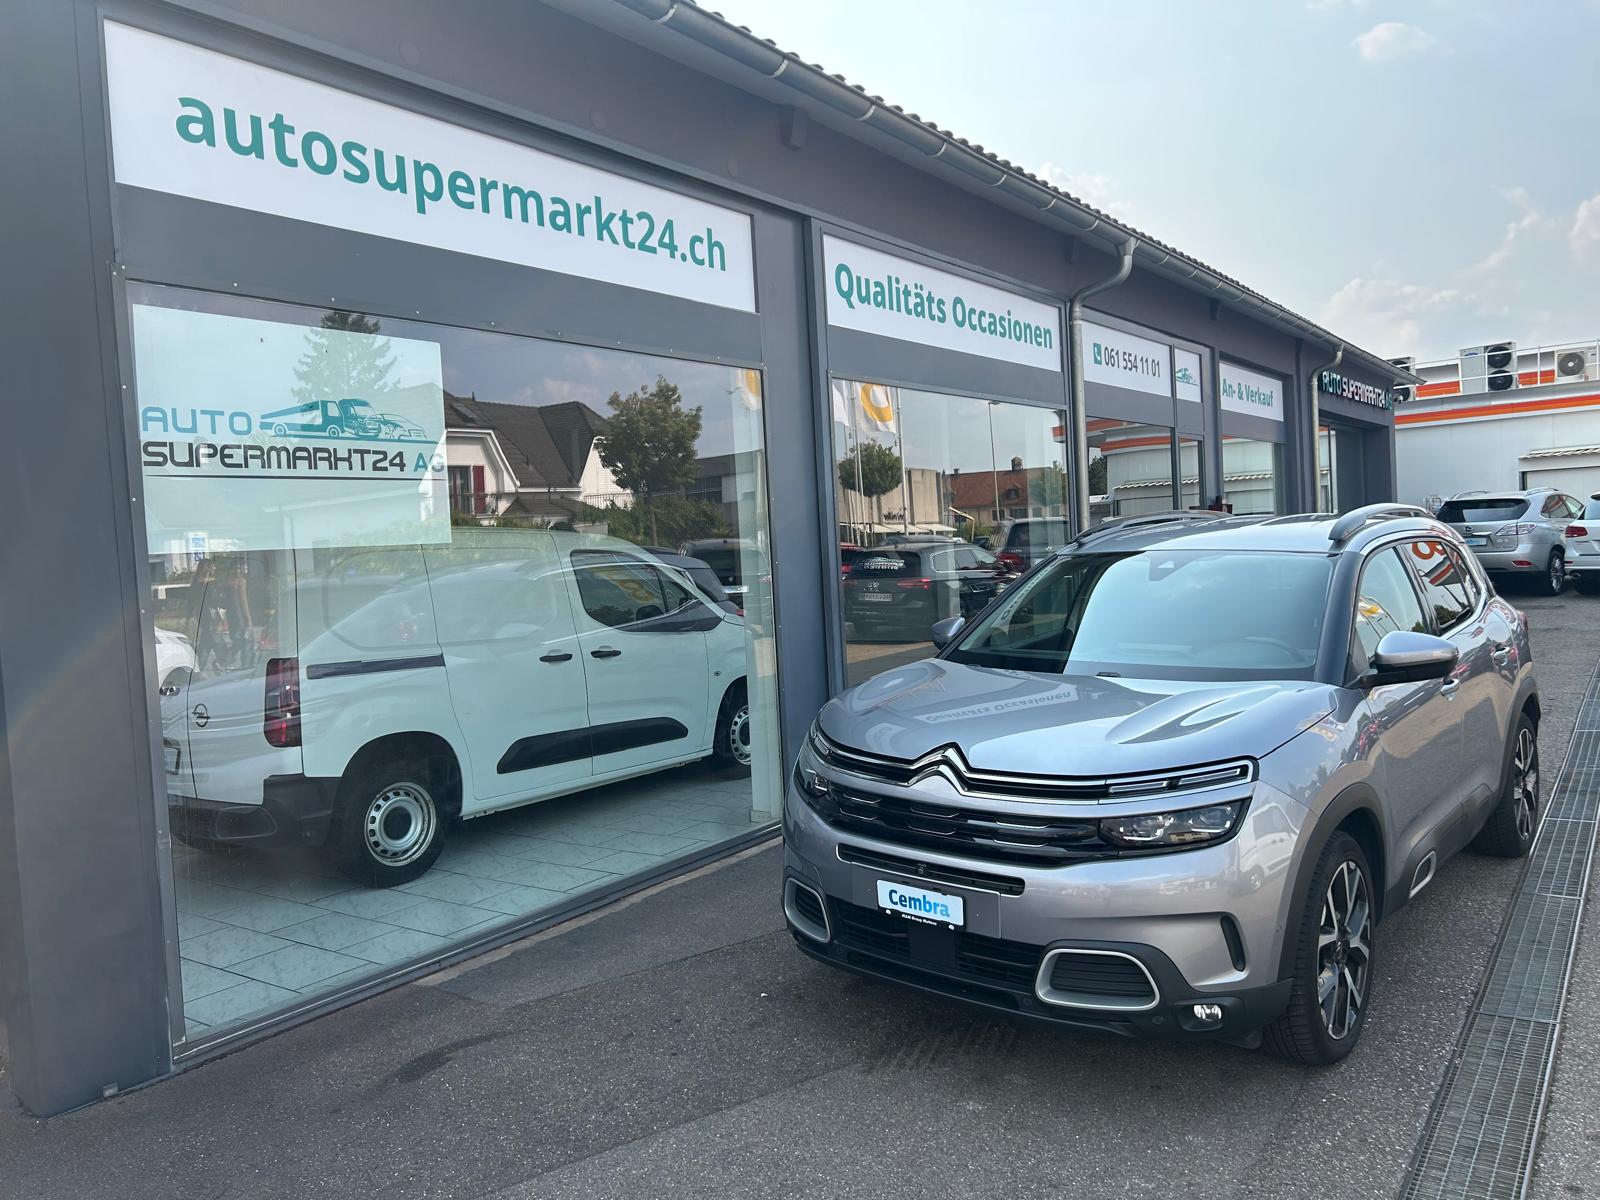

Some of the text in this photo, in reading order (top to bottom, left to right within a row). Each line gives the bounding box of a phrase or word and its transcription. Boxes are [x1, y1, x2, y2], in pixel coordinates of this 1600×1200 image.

[175, 96, 727, 272] autosupermarkt24.ch
[834, 263, 1053, 350] Qualitäts Occasionen
[1104, 346, 1160, 378] 061 554 11 01
[1222, 378, 1274, 408] An- & Verkauf
[1323, 371, 1341, 395] AUTO
[141, 406, 252, 435] AUTO
[142, 441, 406, 472] SUPERMARKT24
[888, 889, 950, 917] Cembra
